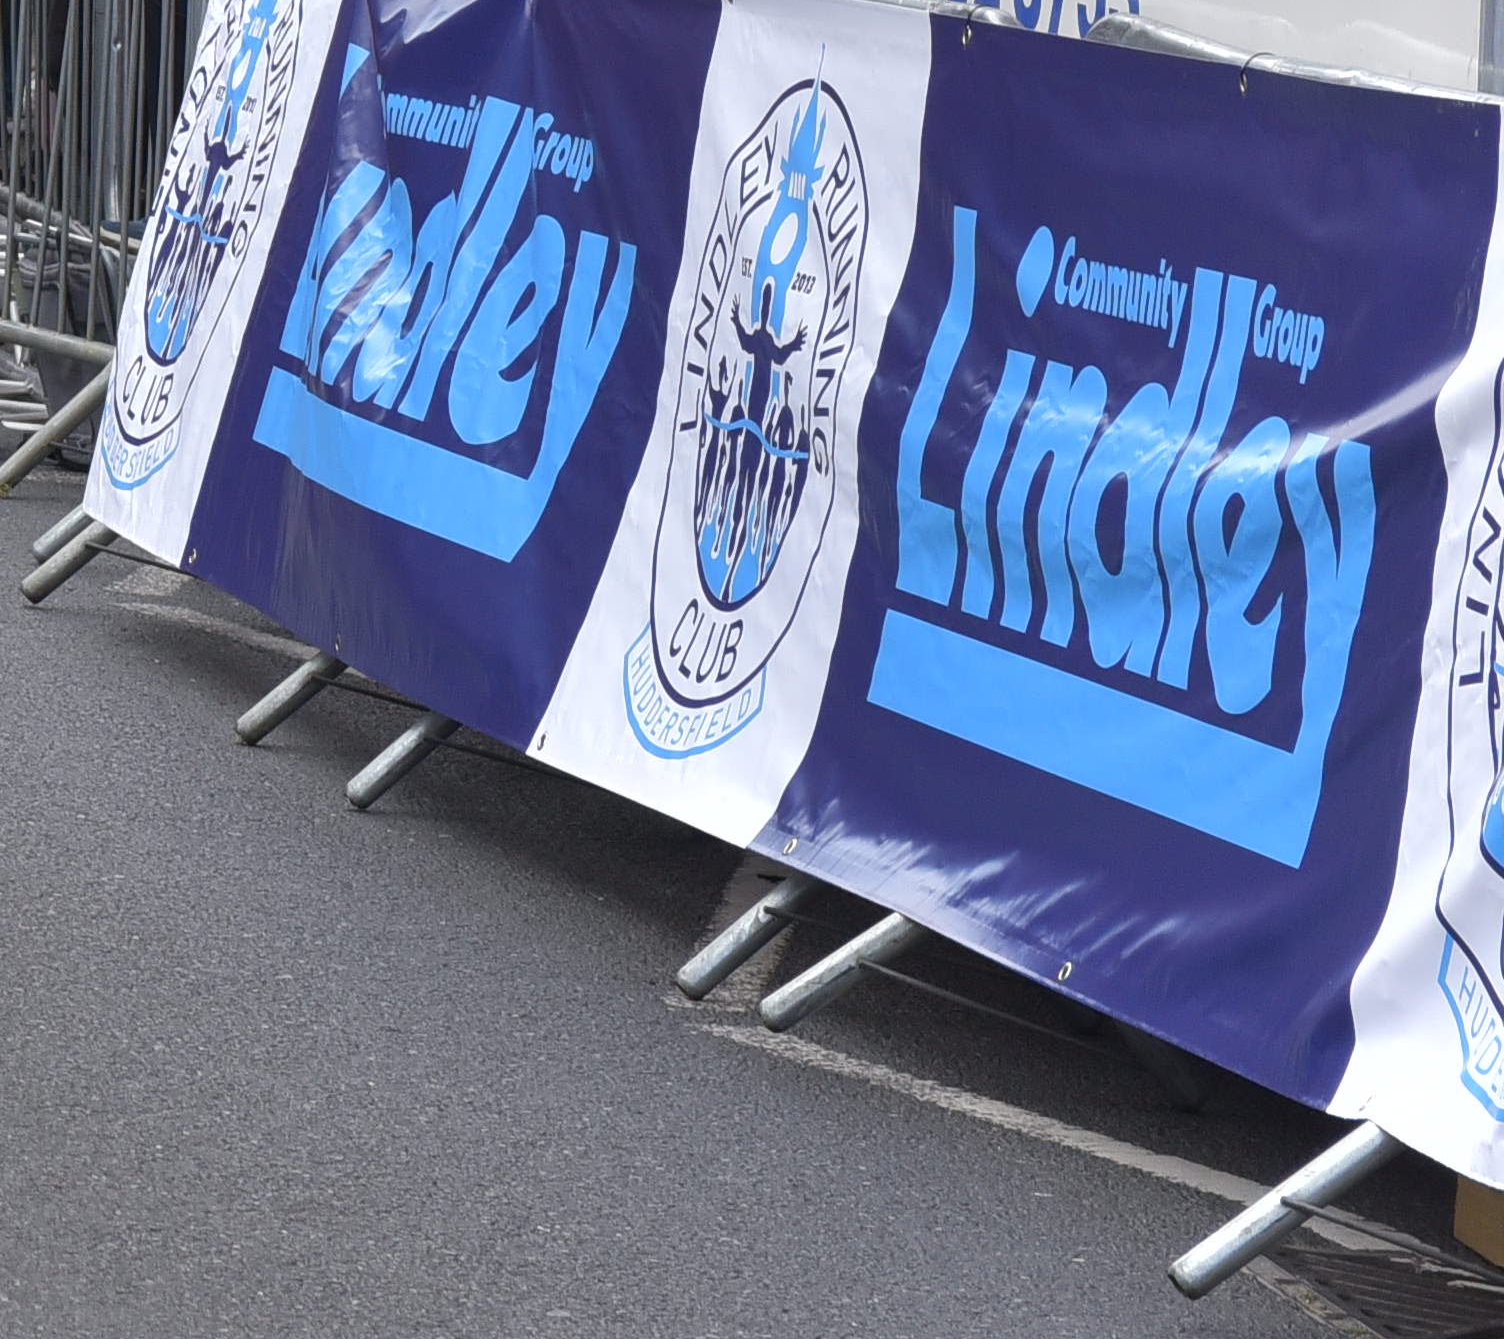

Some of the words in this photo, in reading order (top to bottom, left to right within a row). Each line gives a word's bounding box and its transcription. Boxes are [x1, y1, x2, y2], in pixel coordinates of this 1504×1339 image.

[530, 106, 595, 194] Group
[678, 120, 780, 432] LINDLEY
[810, 141, 861, 479] RUNNING
[740, 256, 753, 278] EST.
[793, 271, 817, 294] 2013
[1053, 235, 1188, 349] Community
[1252, 283, 1325, 385] Group
[122, 354, 176, 425] CLUB
[895, 205, 1376, 716] Lindley
[669, 598, 744, 680] CLUB
[630, 643, 754, 747] HUDDERSFIELD
